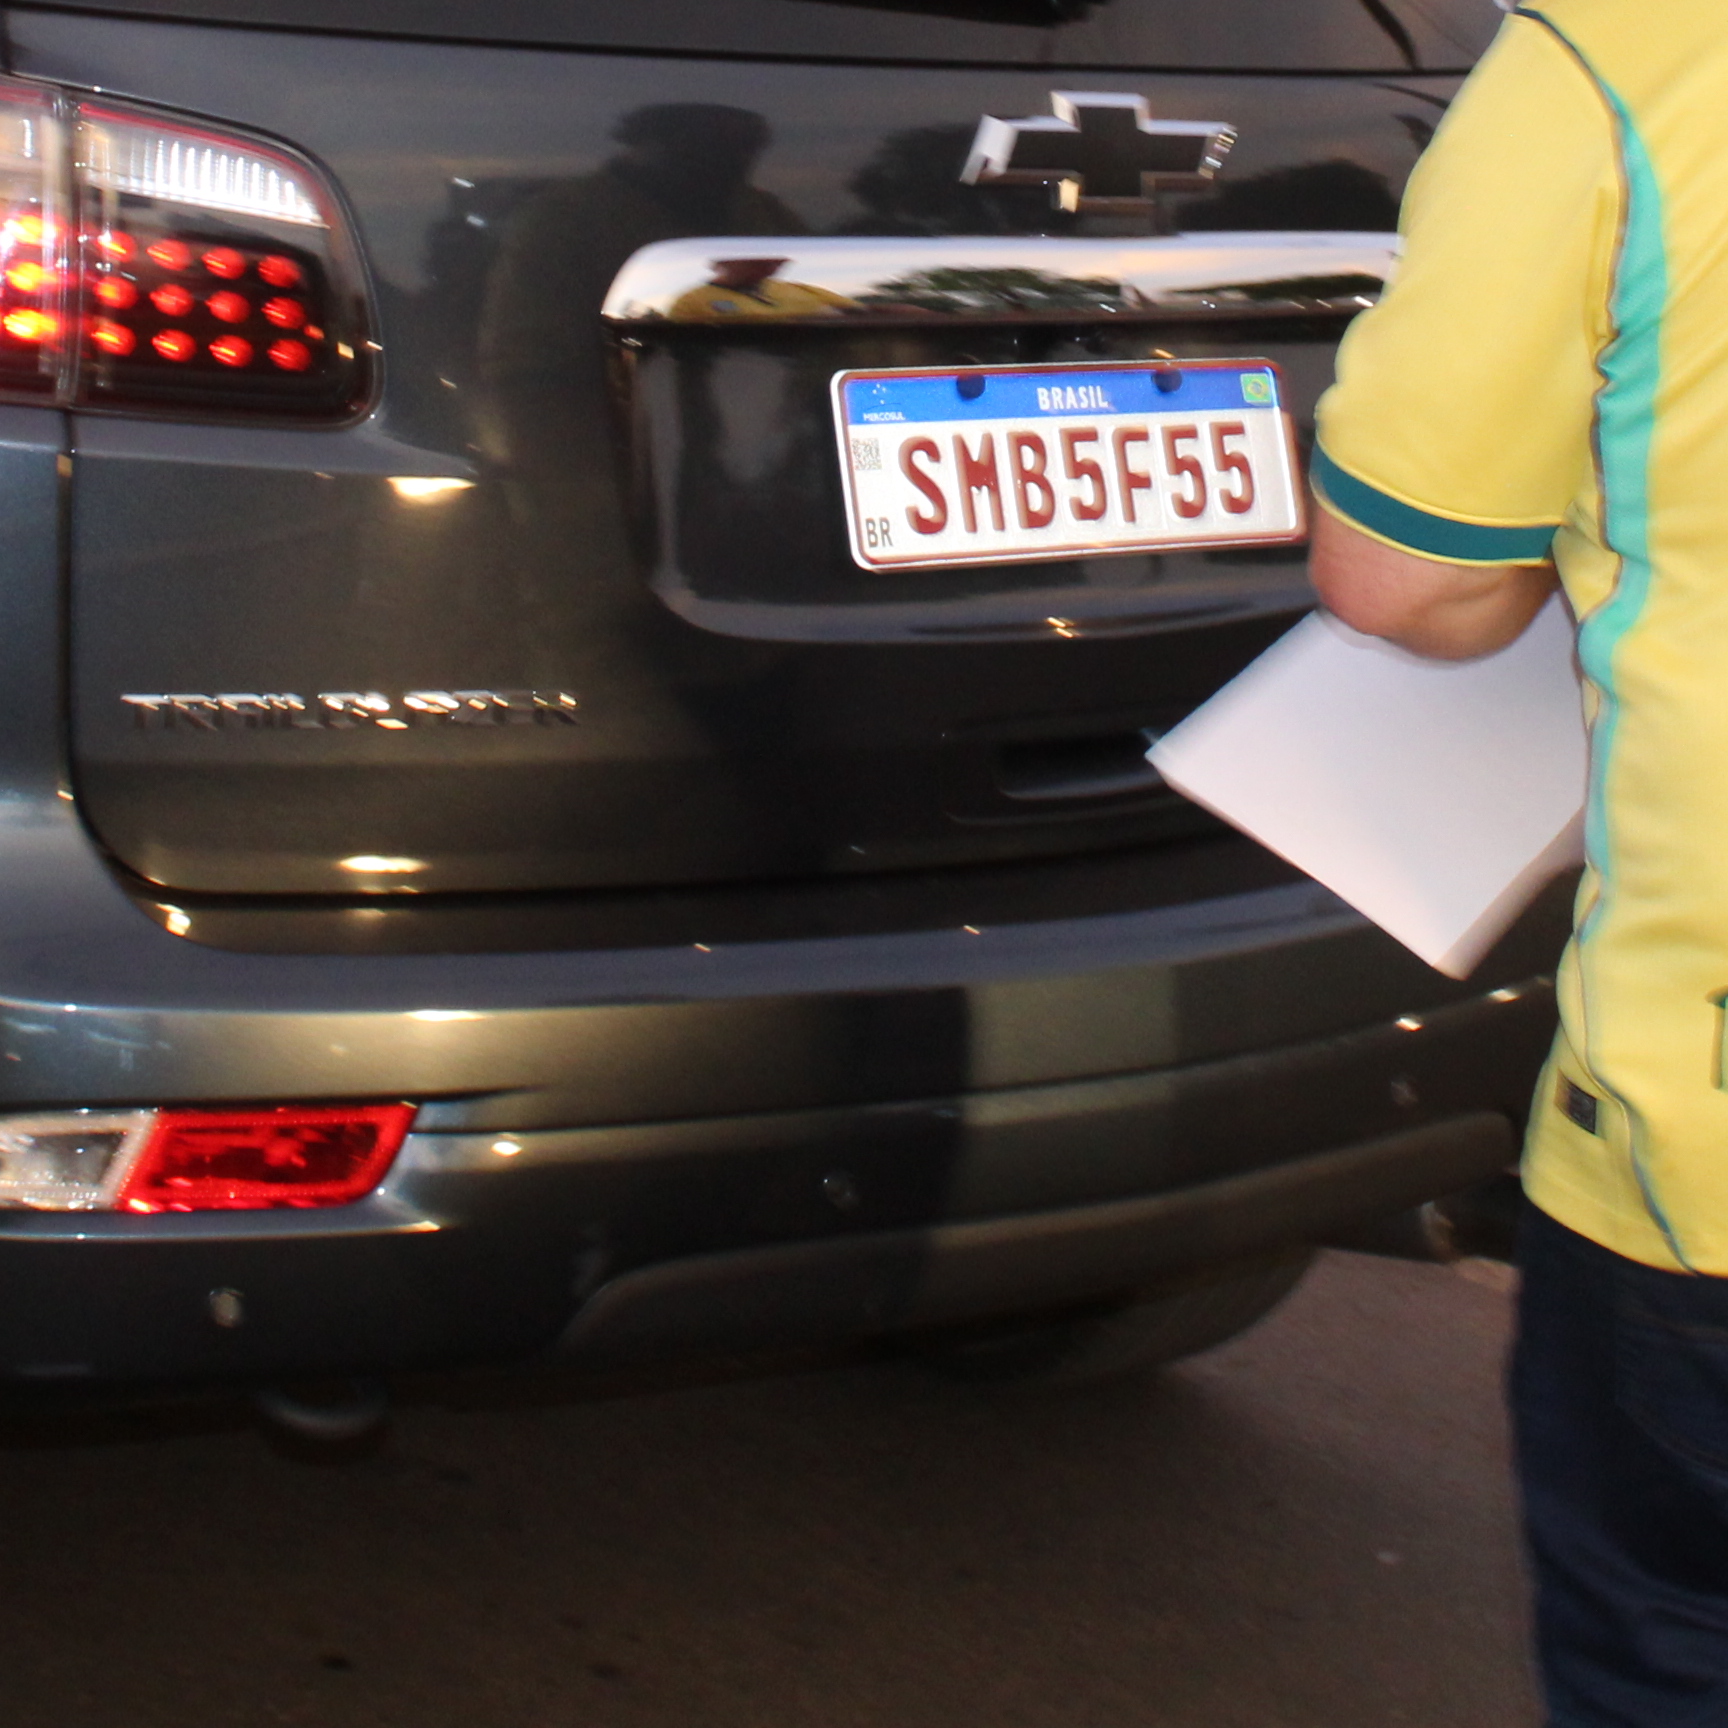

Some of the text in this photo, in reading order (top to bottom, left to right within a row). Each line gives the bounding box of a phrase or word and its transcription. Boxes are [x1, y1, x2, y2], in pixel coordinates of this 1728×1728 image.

[1036, 385, 1109, 411] BRASIL
[862, 411, 906, 422] MERCOSUL
[898, 419, 1255, 535] SMB5F55
[865, 516, 893, 549] BR
